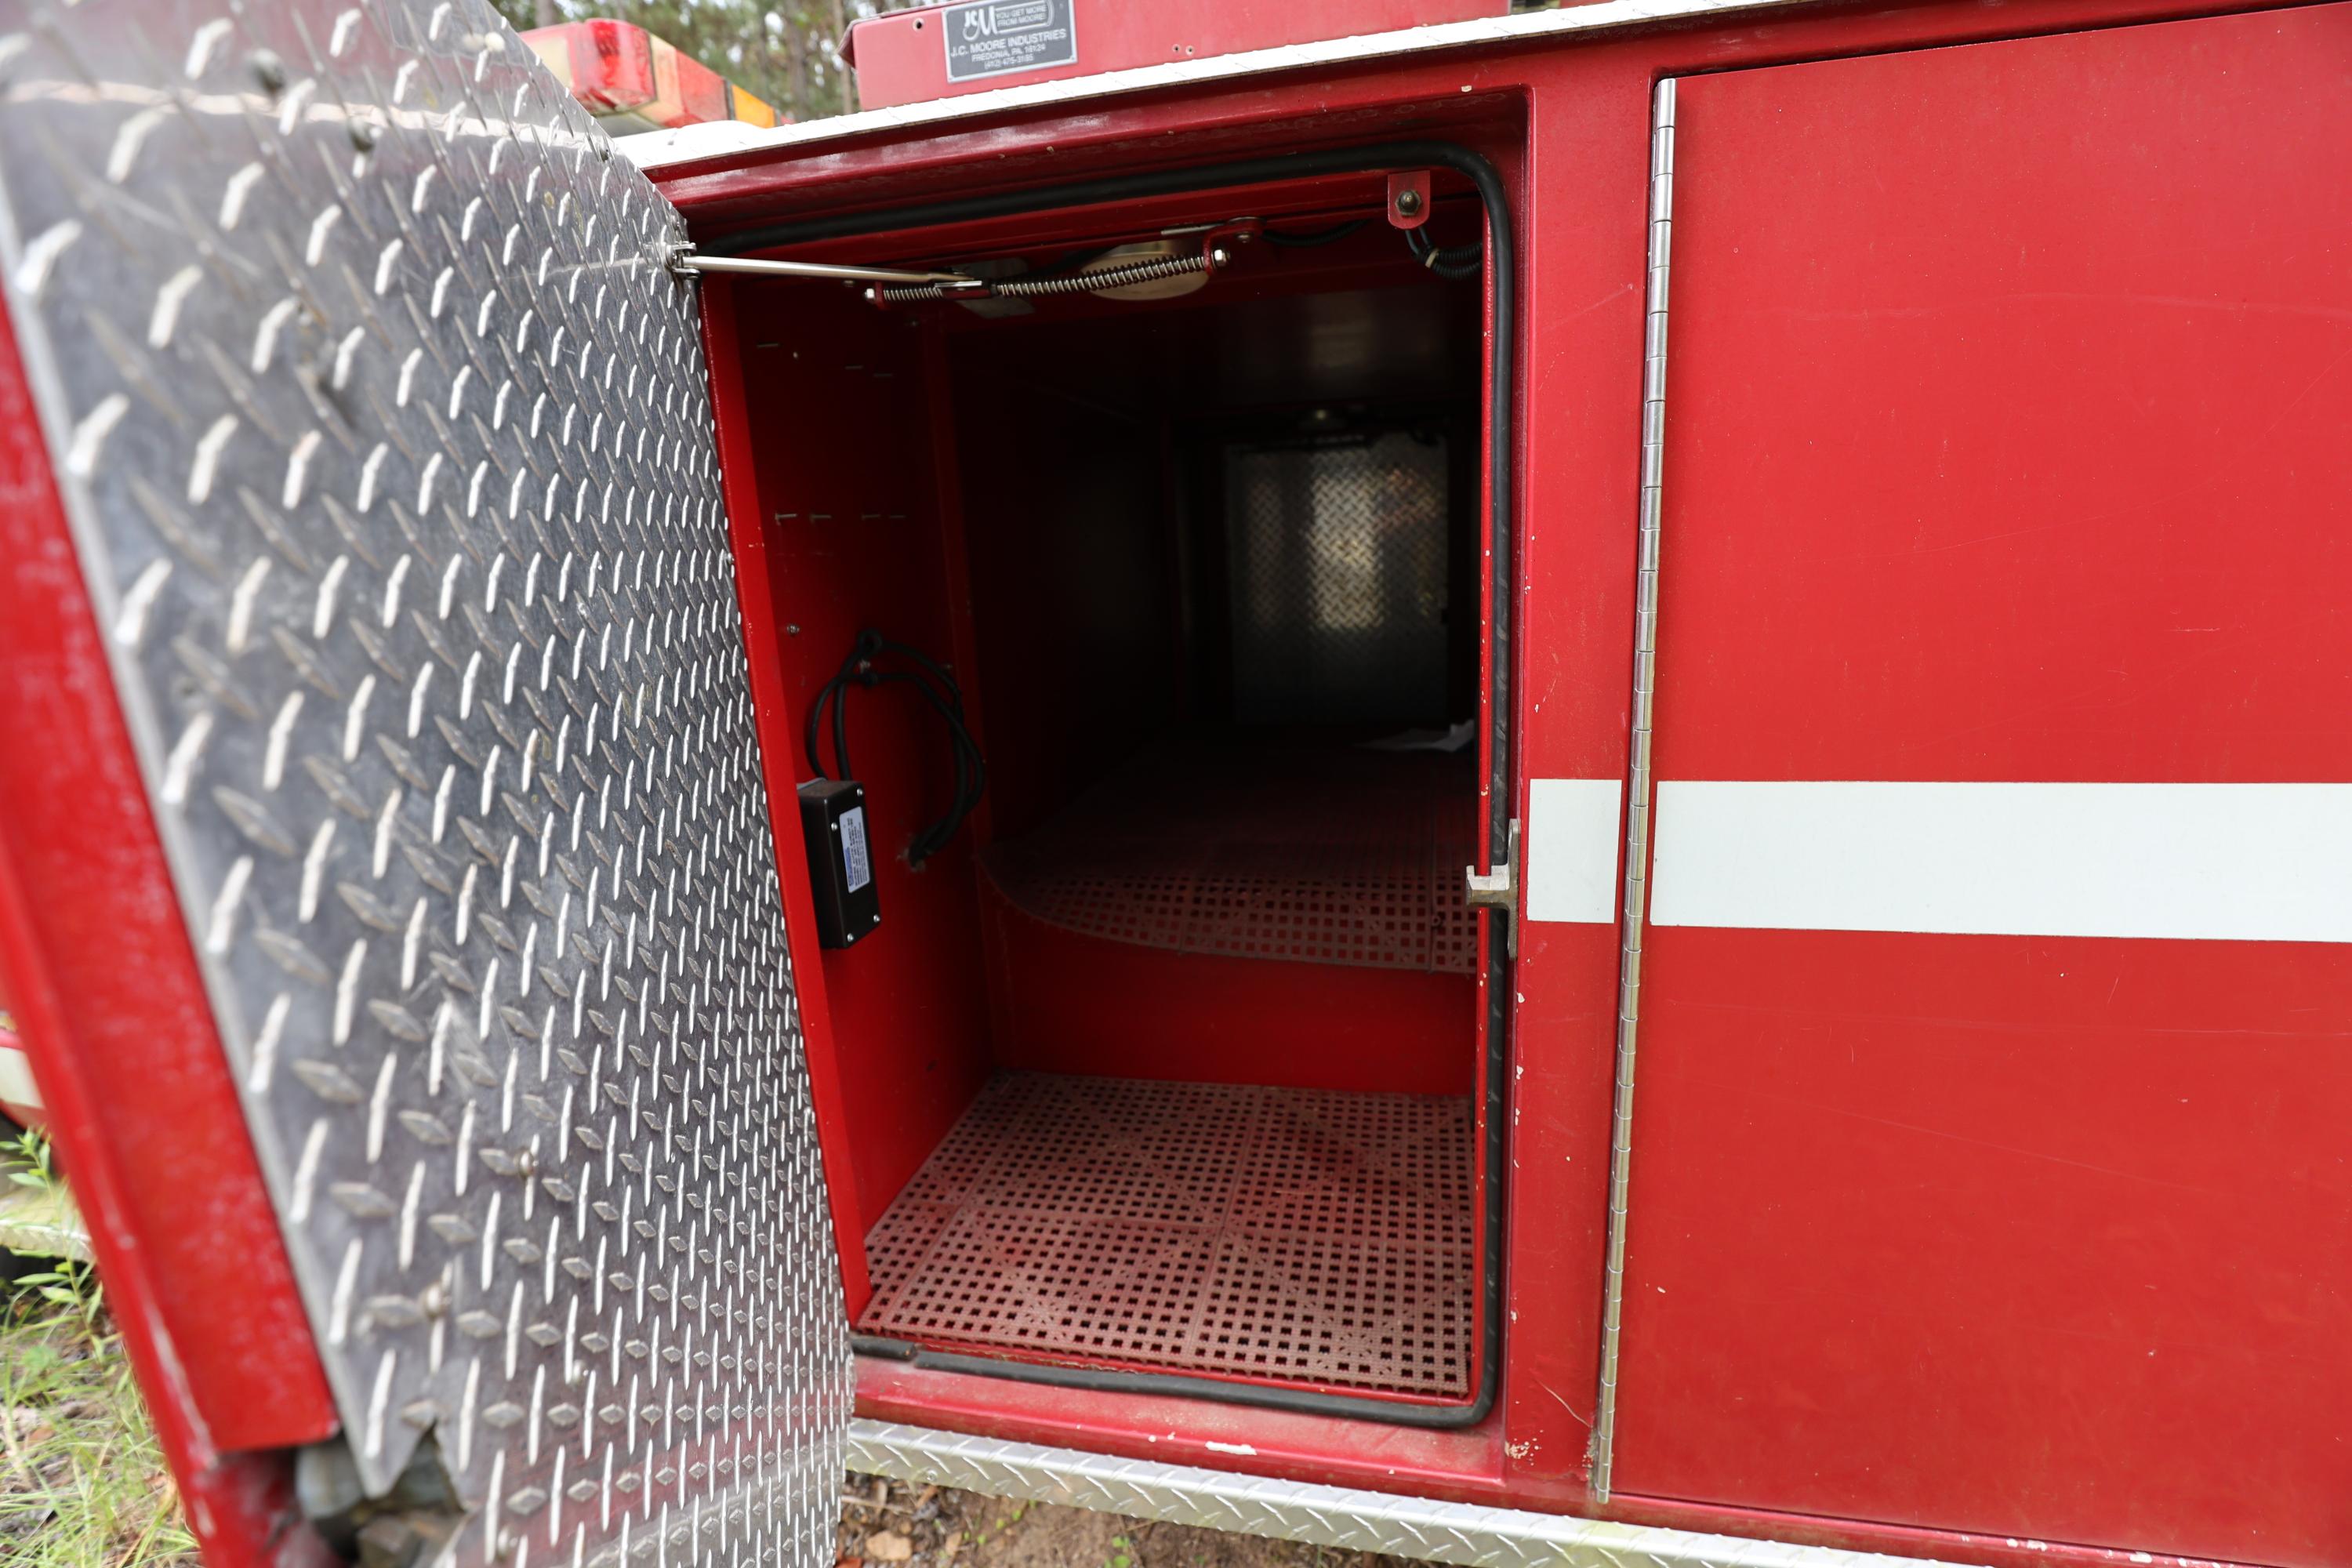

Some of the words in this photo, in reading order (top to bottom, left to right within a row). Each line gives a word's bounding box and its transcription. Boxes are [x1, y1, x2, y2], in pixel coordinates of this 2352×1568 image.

[1011, 8, 1025, 16] GET
[1025, 5, 1047, 14] MORE
[997, 18, 1017, 27] FROM
[951, 45, 968, 57] J.C.
[970, 38, 1007, 53] MOORE
[1007, 29, 1067, 47] INDUSTRIES
